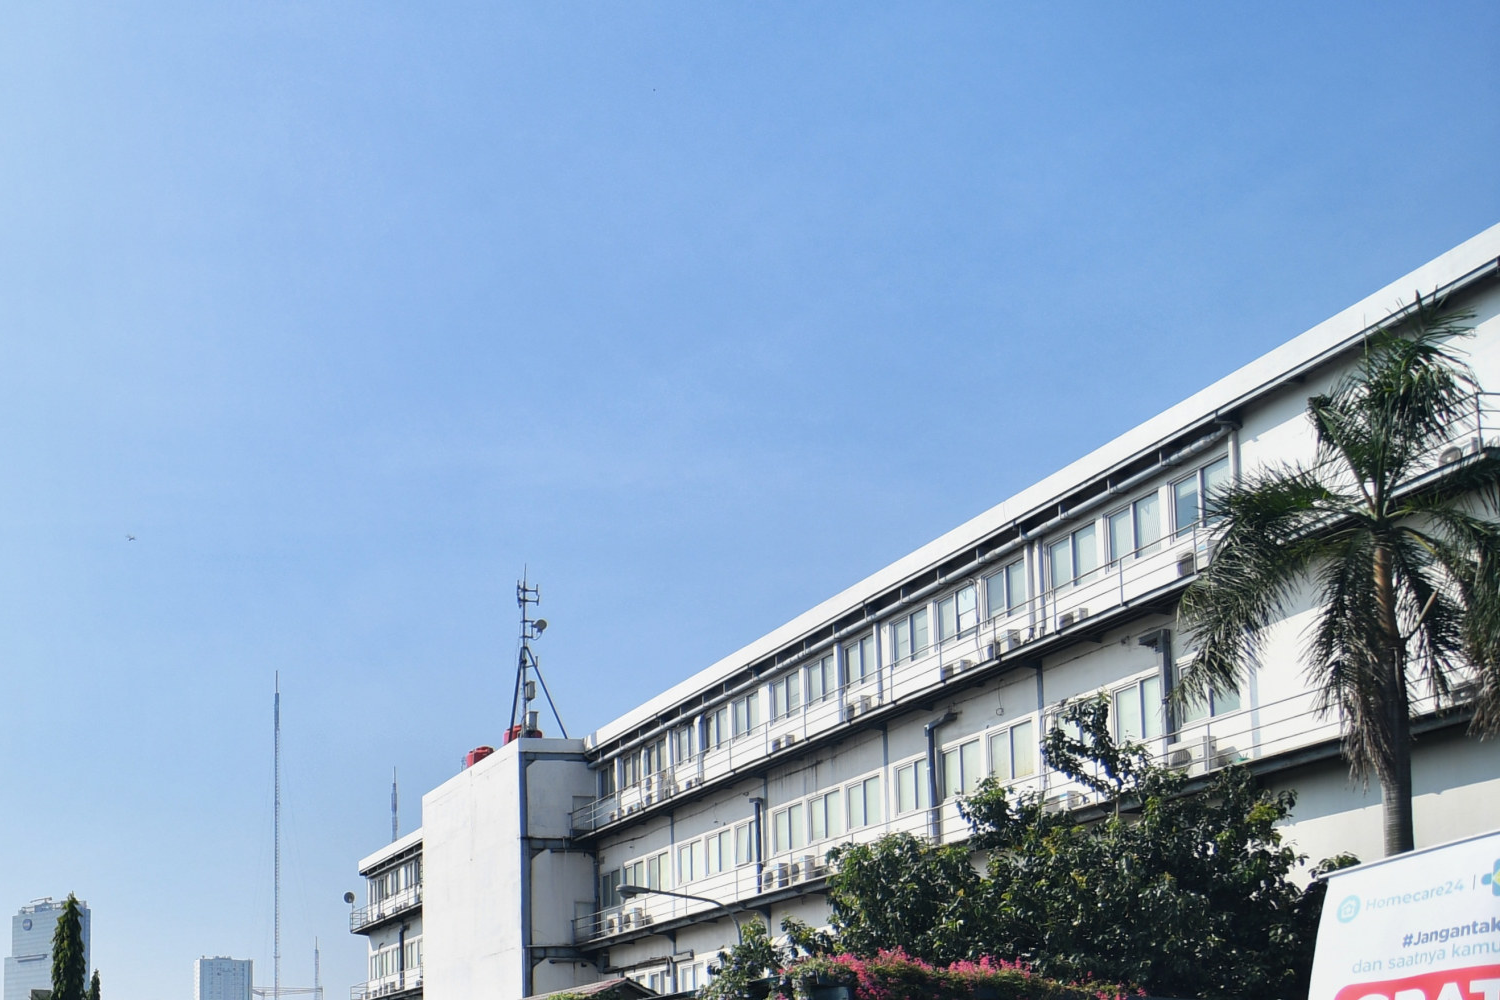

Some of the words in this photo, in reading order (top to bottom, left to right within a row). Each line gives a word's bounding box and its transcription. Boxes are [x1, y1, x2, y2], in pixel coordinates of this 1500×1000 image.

[1365, 878, 1465, 912] Homecare24
[1352, 959, 1382, 974] dan
[1388, 948, 1446, 970] saatnya
